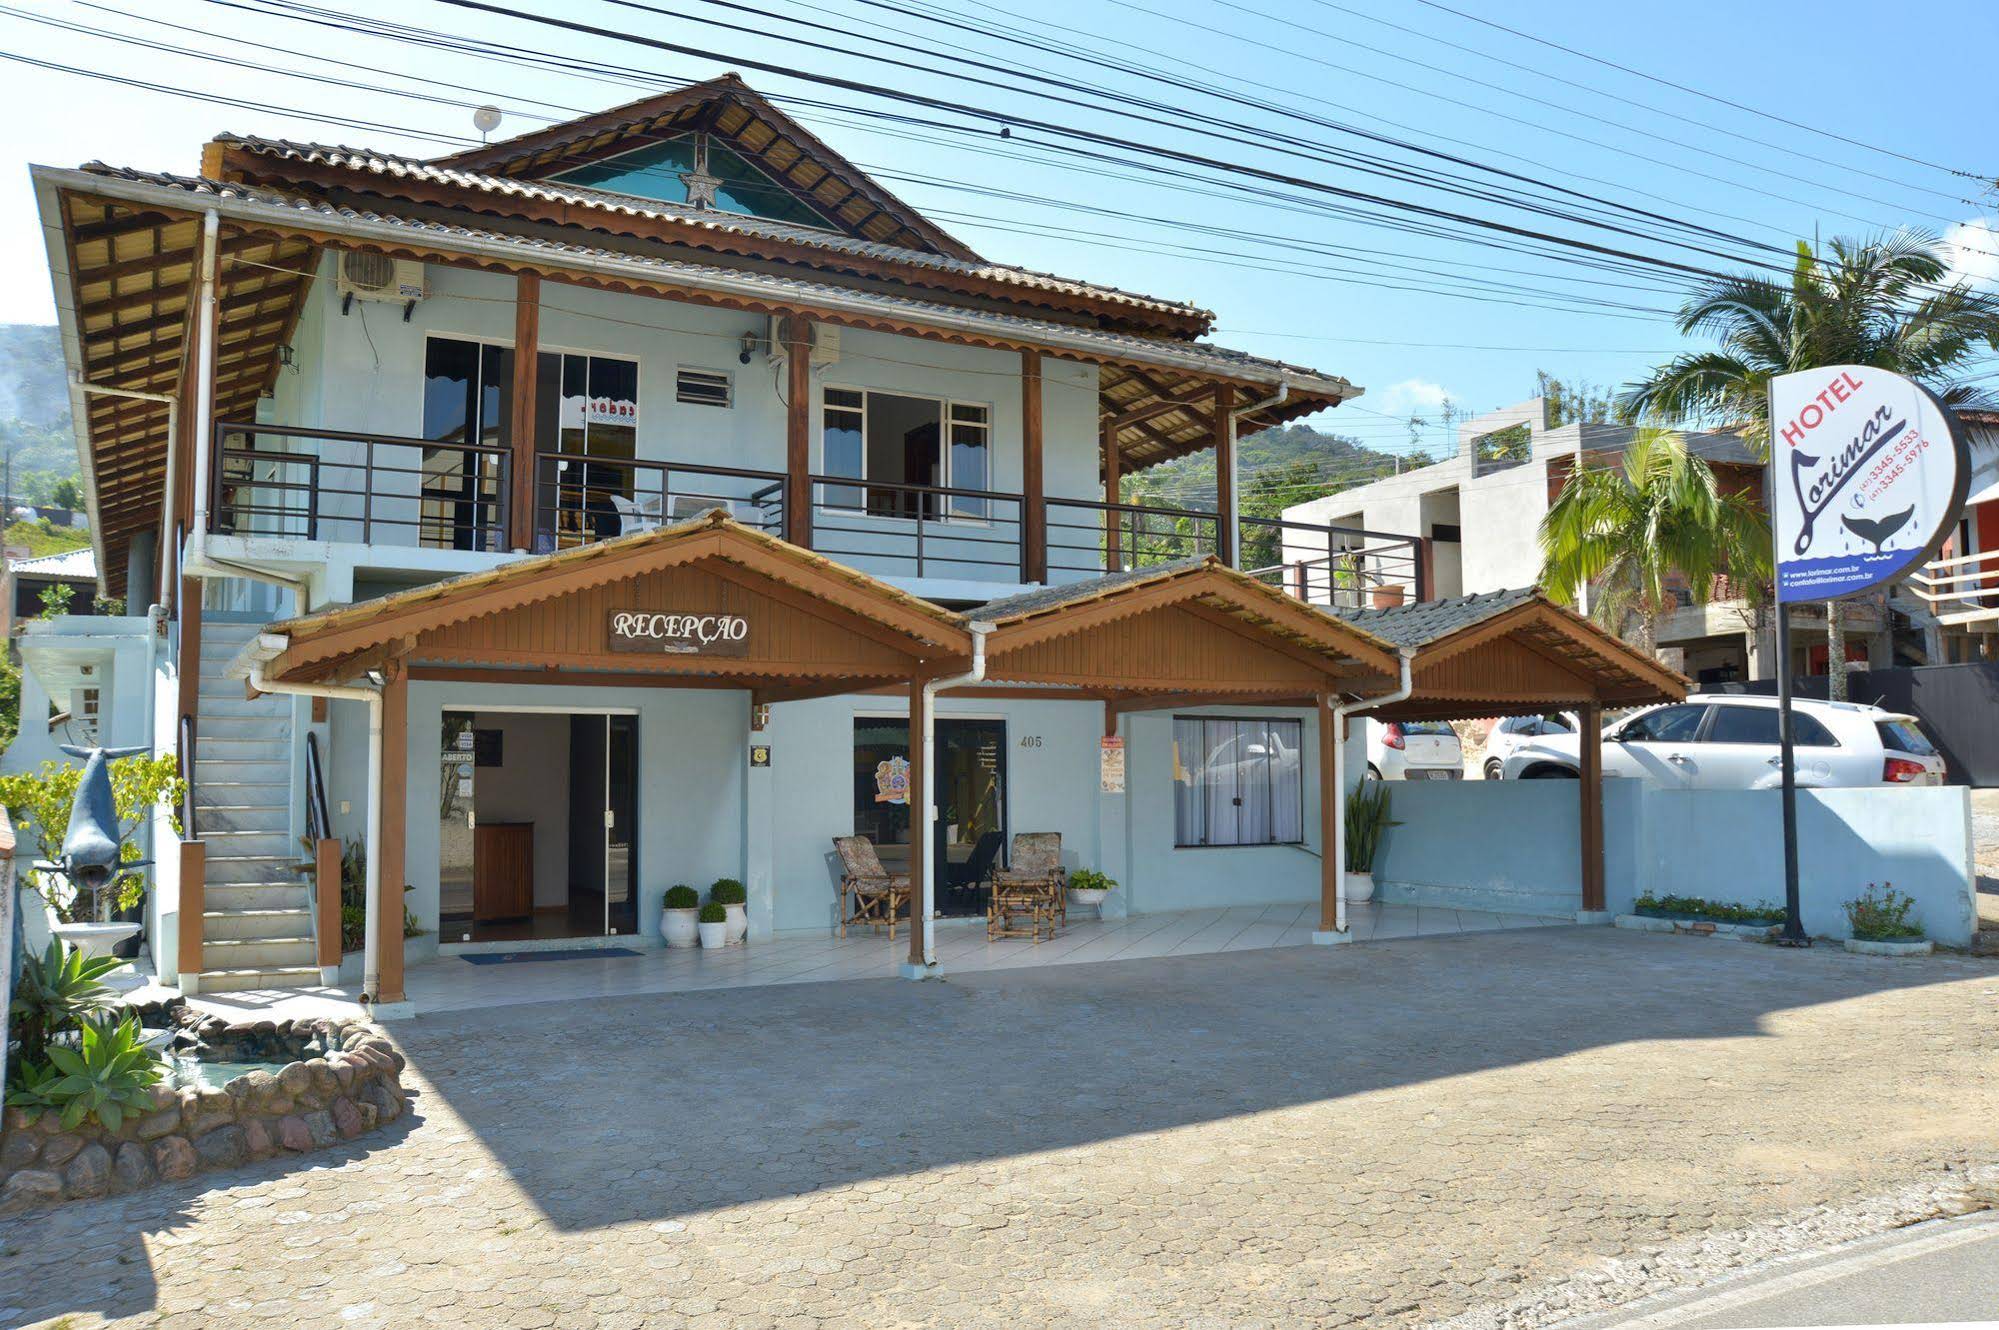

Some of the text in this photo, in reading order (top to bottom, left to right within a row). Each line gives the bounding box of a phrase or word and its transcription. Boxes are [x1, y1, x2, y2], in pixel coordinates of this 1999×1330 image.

[1779, 372, 1863, 447] HOTEL
[1870, 430, 1918, 479] 3345-5533
[1880, 440, 1929, 489] 3345-5976
[1791, 404, 1906, 555] Lorimar
[1789, 566, 1860, 578] www.lorimar.com.br
[1789, 573, 1873, 587] contato@lorimar.com.br
[613, 612, 748, 645] RECEPÇÃO
[441, 753, 473, 762] ABERTO
[1020, 736, 1042, 748] 405
